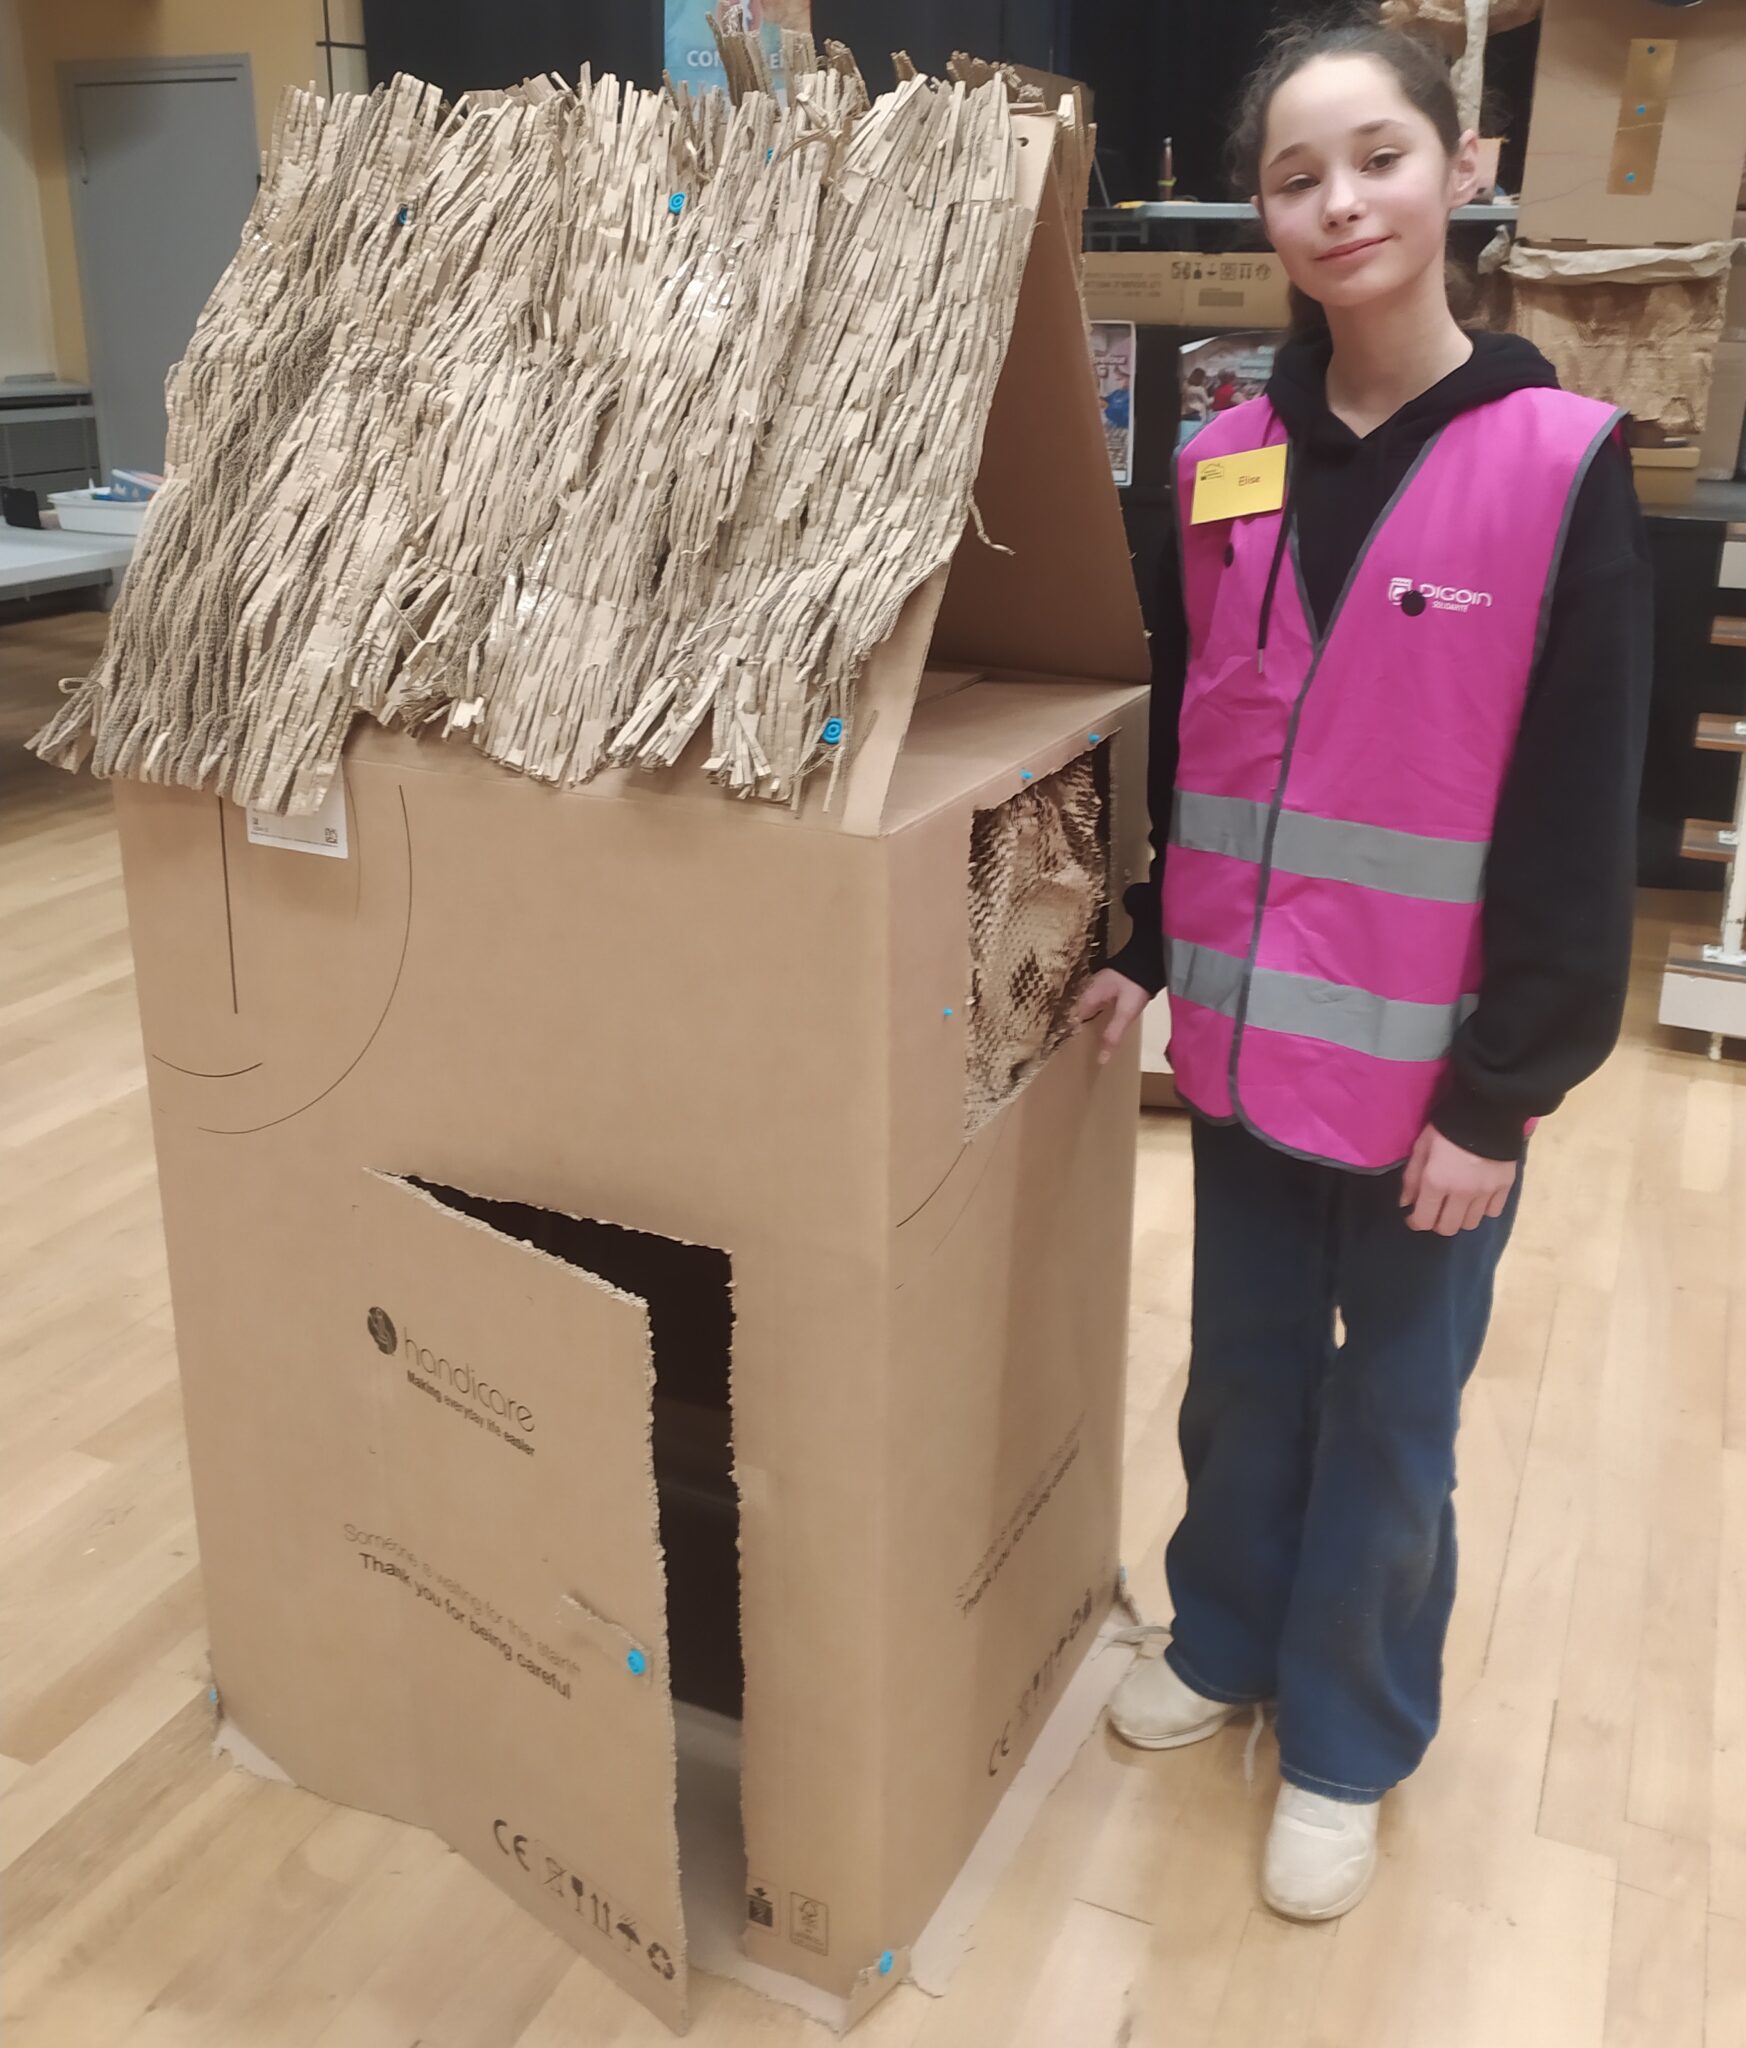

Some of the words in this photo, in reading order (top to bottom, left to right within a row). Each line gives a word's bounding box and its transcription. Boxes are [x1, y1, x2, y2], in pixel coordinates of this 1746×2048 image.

[403, 1326, 536, 1432] handicare
[407, 1369, 442, 1403] Making
[444, 1395, 485, 1429] everyday
[503, 1431, 536, 1456] easier
[358, 1552, 412, 1588] Thank
[414, 1580, 441, 1608] you
[446, 1598, 465, 1624] for
[469, 1614, 513, 1662] being
[516, 1652, 572, 1701] careful
